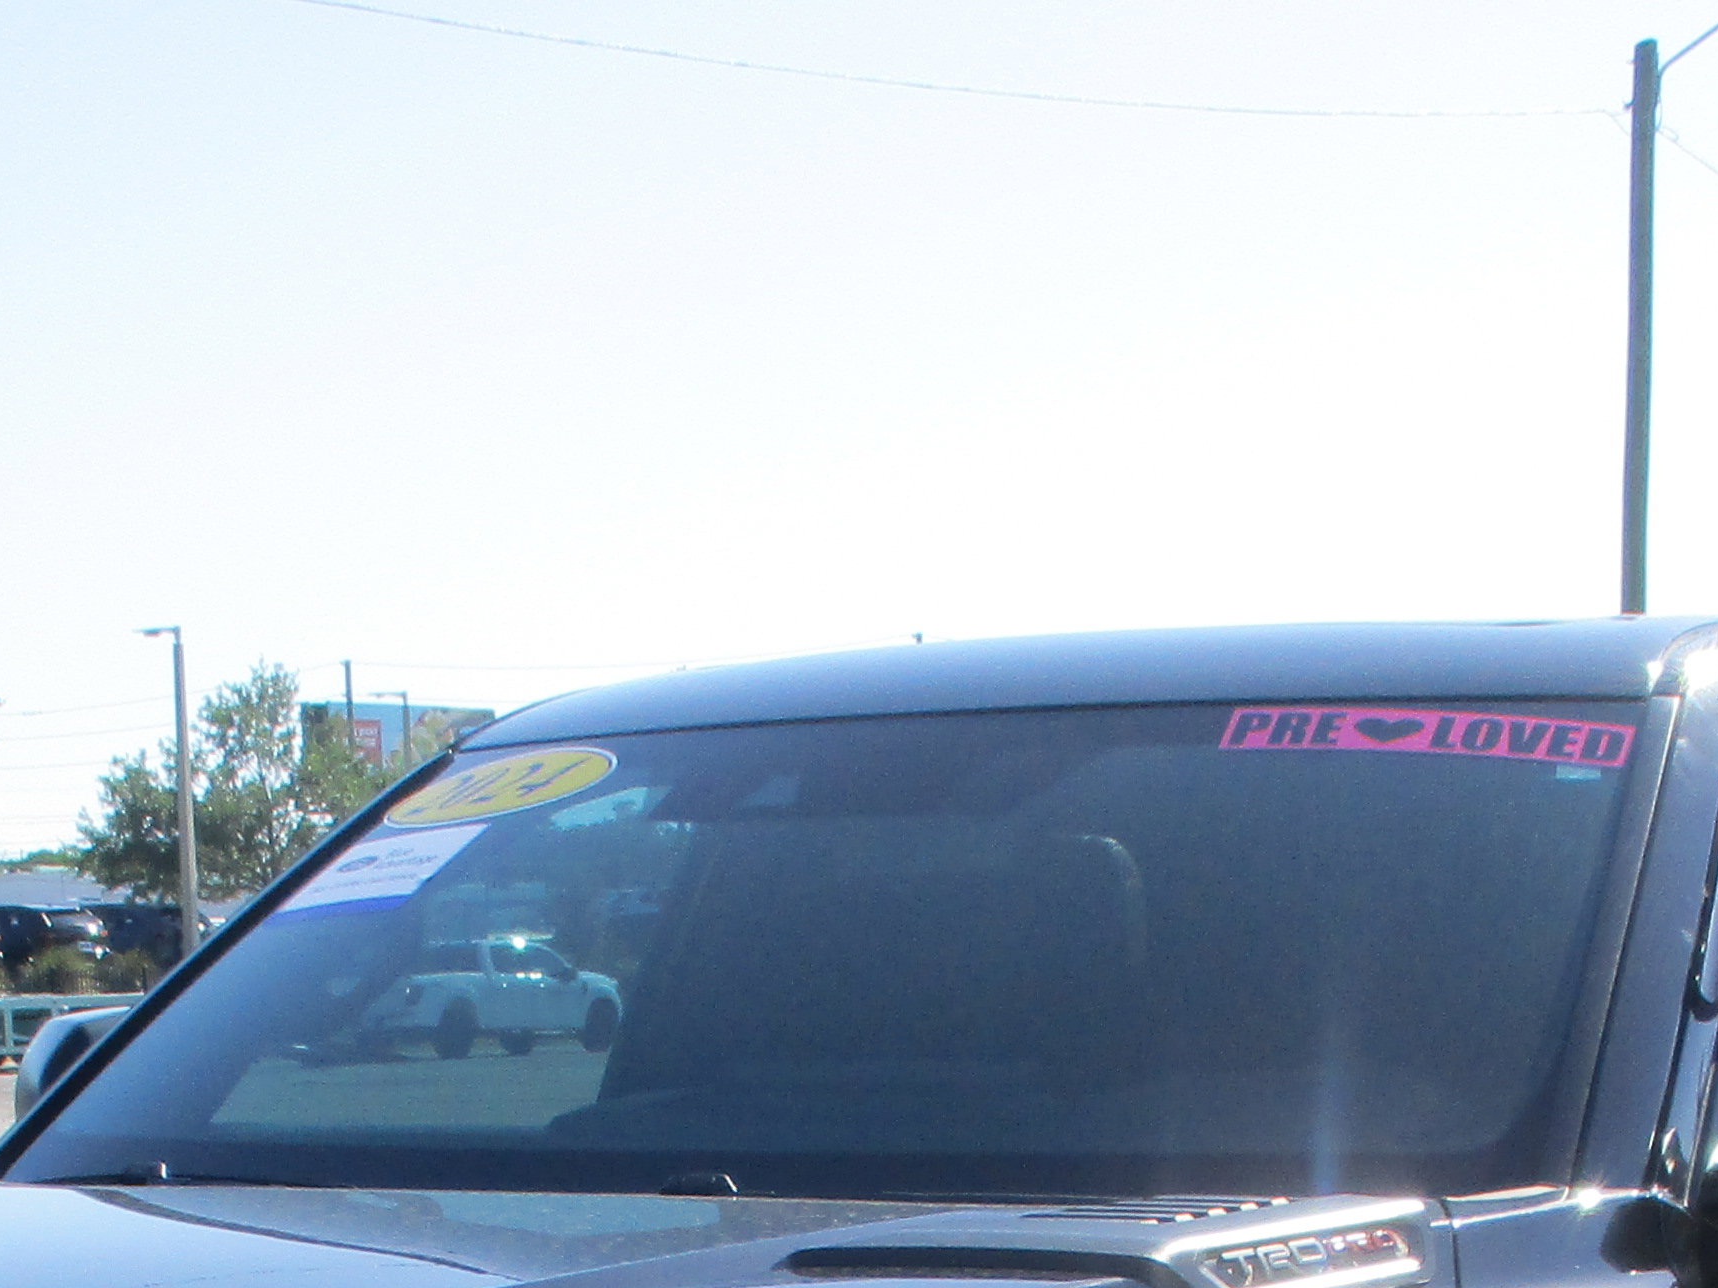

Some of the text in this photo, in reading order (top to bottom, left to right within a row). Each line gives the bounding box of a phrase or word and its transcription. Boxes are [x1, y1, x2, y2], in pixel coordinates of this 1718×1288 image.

[1230, 711, 1628, 762] PRE LOVED
[401, 755, 593, 818] 2024
